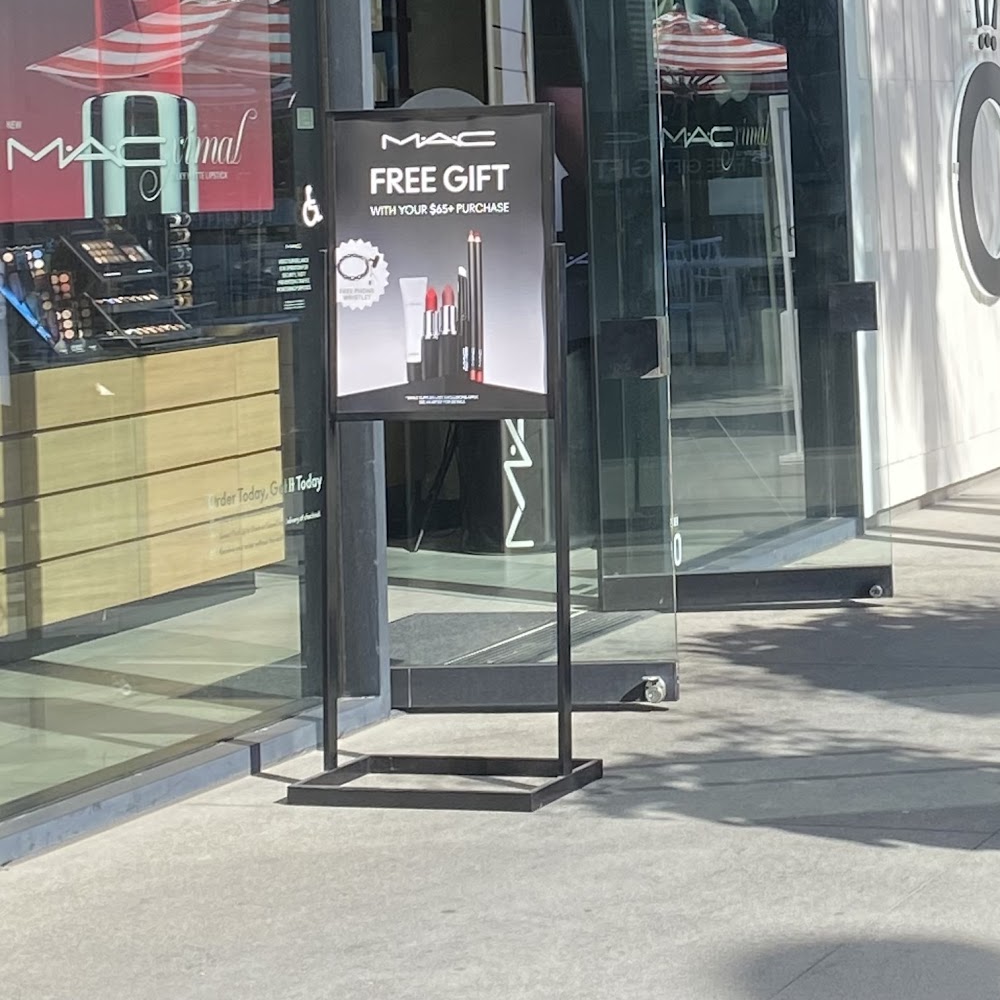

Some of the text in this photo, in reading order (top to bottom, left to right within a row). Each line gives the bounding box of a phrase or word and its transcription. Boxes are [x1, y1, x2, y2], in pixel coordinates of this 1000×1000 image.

[370, 164, 510, 195] FREE GIFT
[370, 206, 397, 216] WITH
[398, 204, 428, 215] YOUR
[456, 202, 510, 214] PURCHASE
[295, 472, 323, 493] Today
